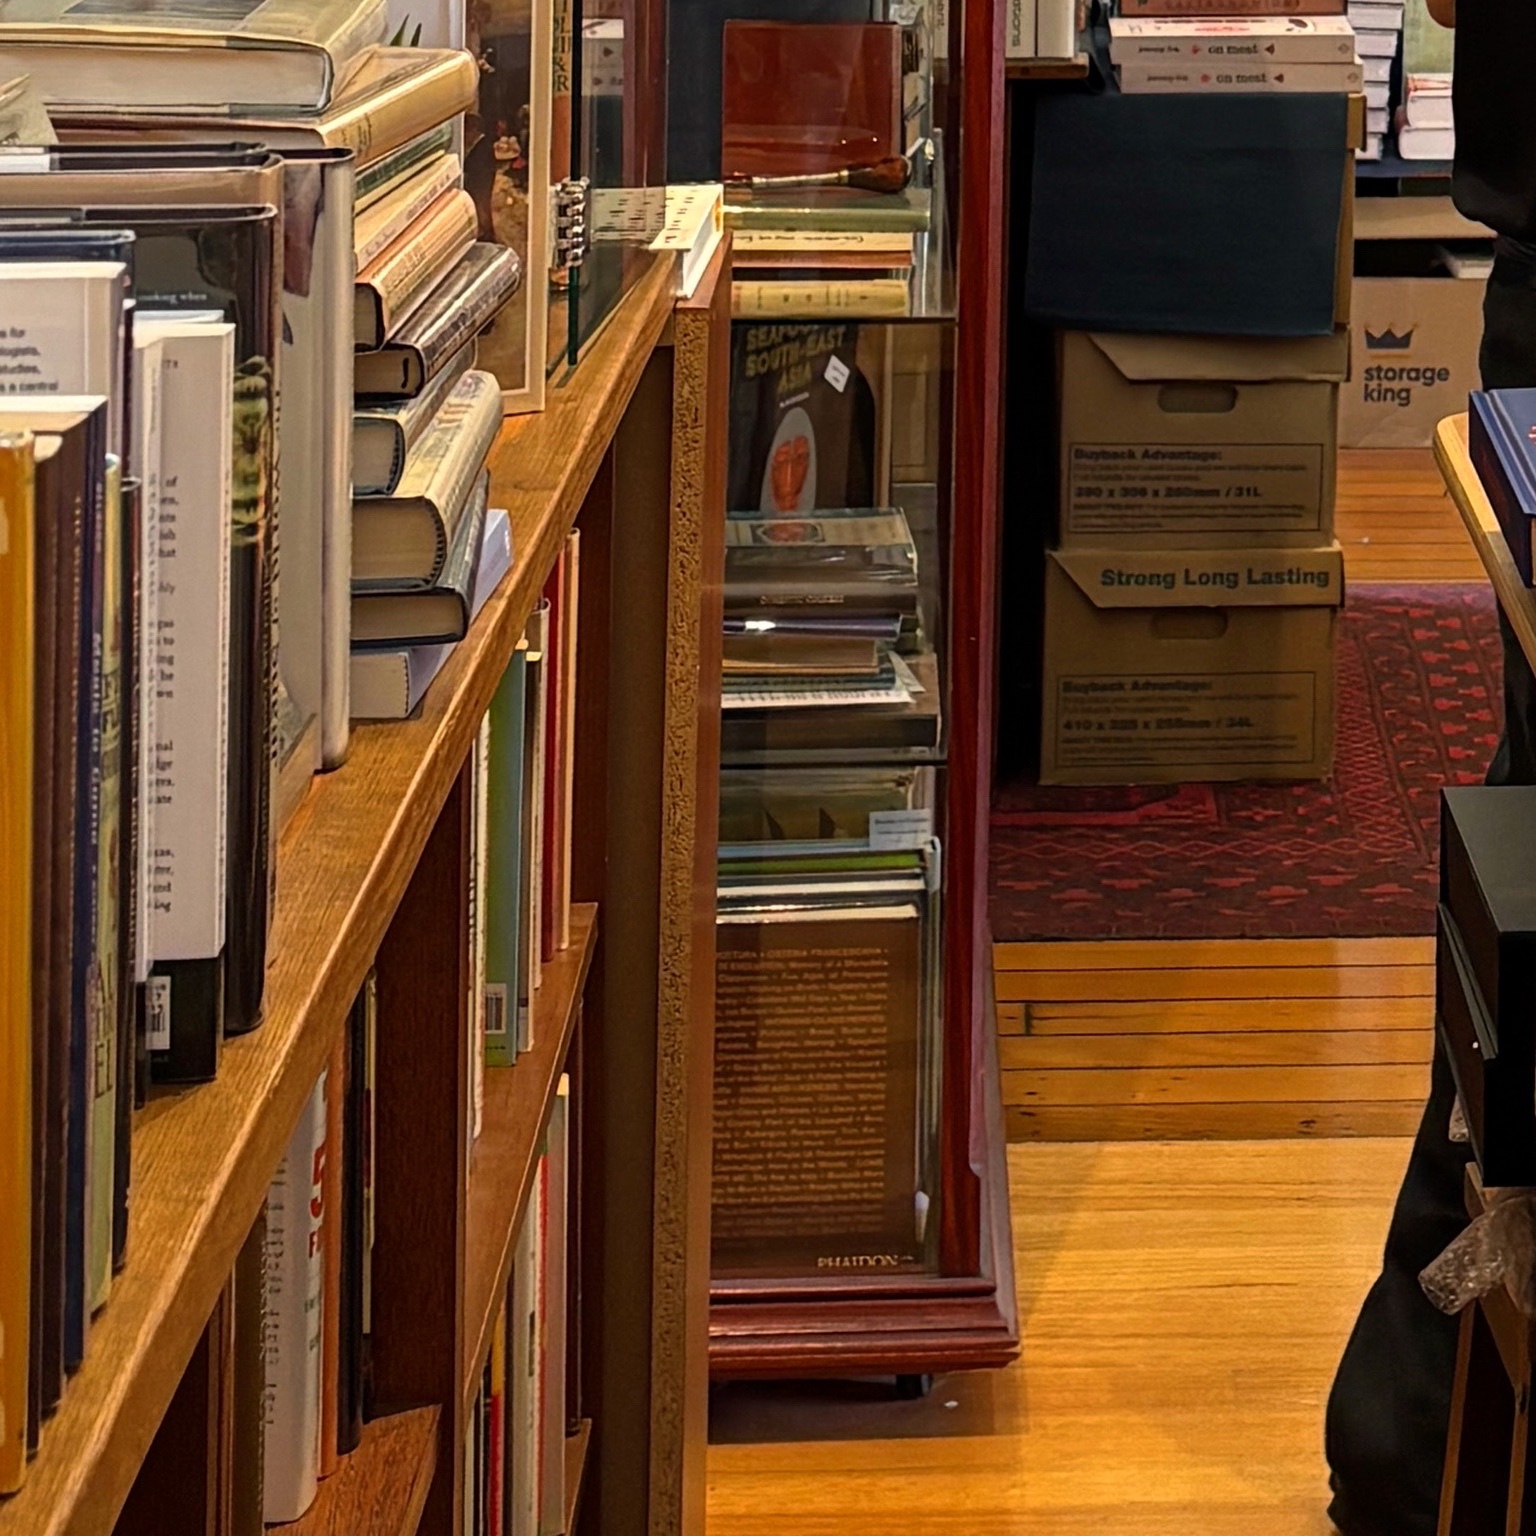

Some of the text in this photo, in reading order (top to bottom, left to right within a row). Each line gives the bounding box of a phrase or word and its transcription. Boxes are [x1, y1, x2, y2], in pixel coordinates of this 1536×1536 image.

[1207, 44, 1259, 55] on meat
[1215, 73, 1267, 84] on meat
[1364, 362, 1451, 388] storage
[1364, 383, 1412, 407] king
[1101, 566, 1331, 590] Strong Long Lasting
